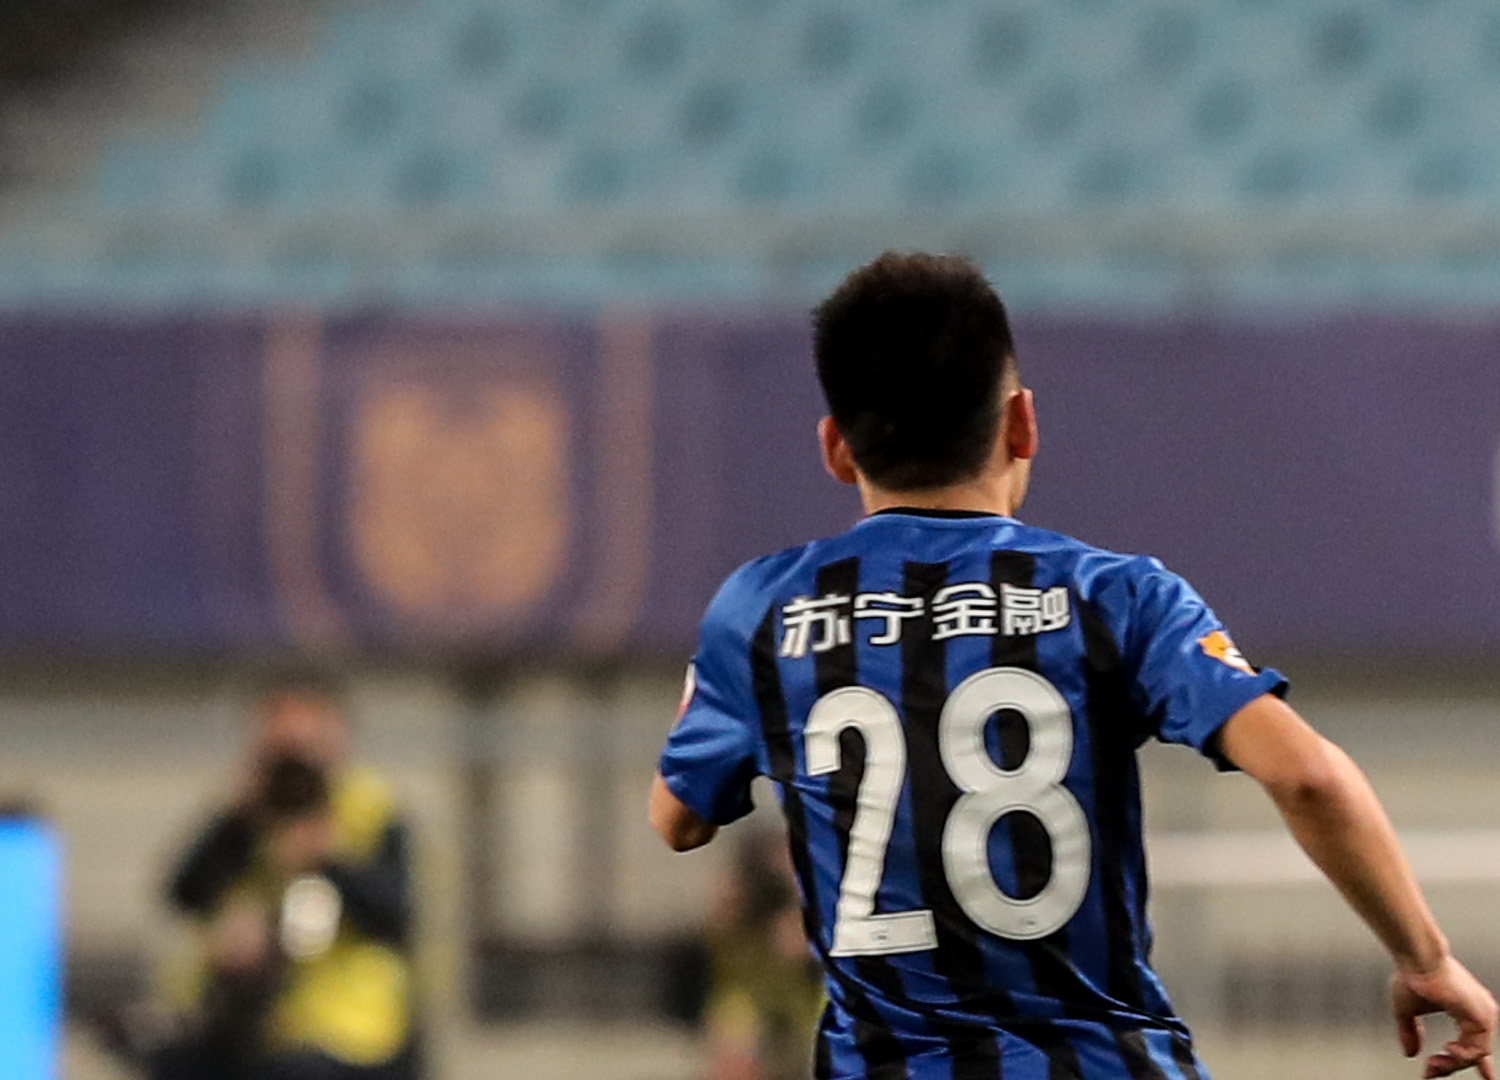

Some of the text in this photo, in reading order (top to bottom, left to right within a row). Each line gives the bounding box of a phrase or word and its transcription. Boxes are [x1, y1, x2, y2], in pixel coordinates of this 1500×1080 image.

[780, 582, 1072, 659] 苏宁金融
[803, 666, 1092, 957] 28
